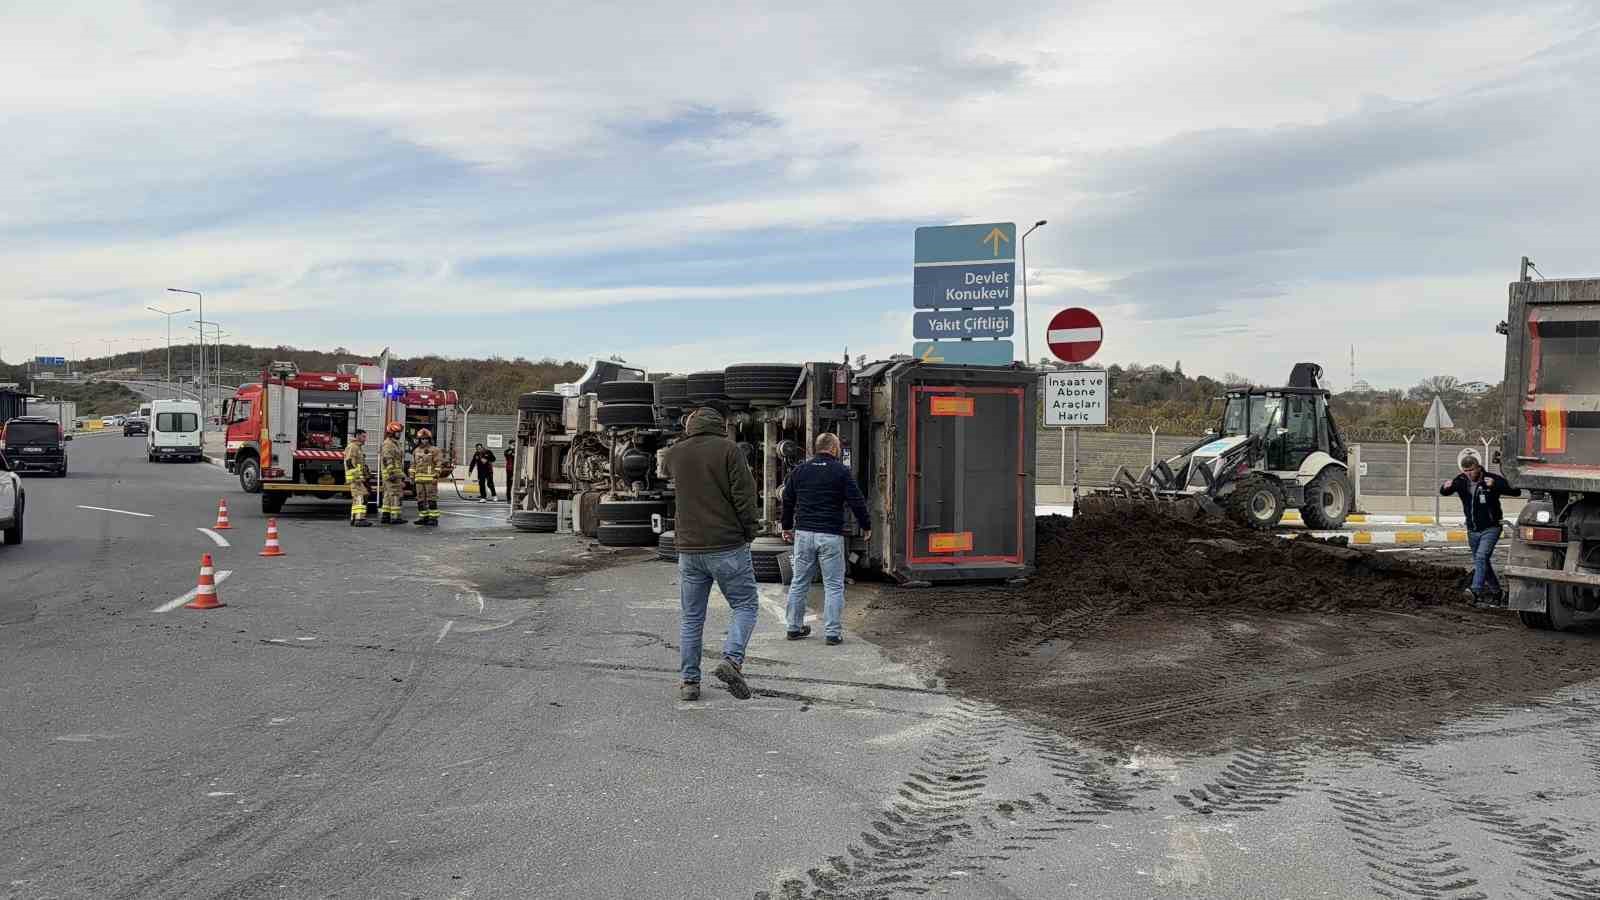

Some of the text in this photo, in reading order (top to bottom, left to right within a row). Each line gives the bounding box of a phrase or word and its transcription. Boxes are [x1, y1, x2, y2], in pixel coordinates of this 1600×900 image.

[964, 272, 1009, 285] Devlet
[945, 287, 1009, 301] Konukevi
[928, 316, 1009, 333] Yakıt Çiftliği
[337, 382, 350, 391] 38
[1057, 387, 1096, 396] Abone
[1052, 400, 1101, 409] Araçları
[1058, 411, 1089, 421] Hariç
